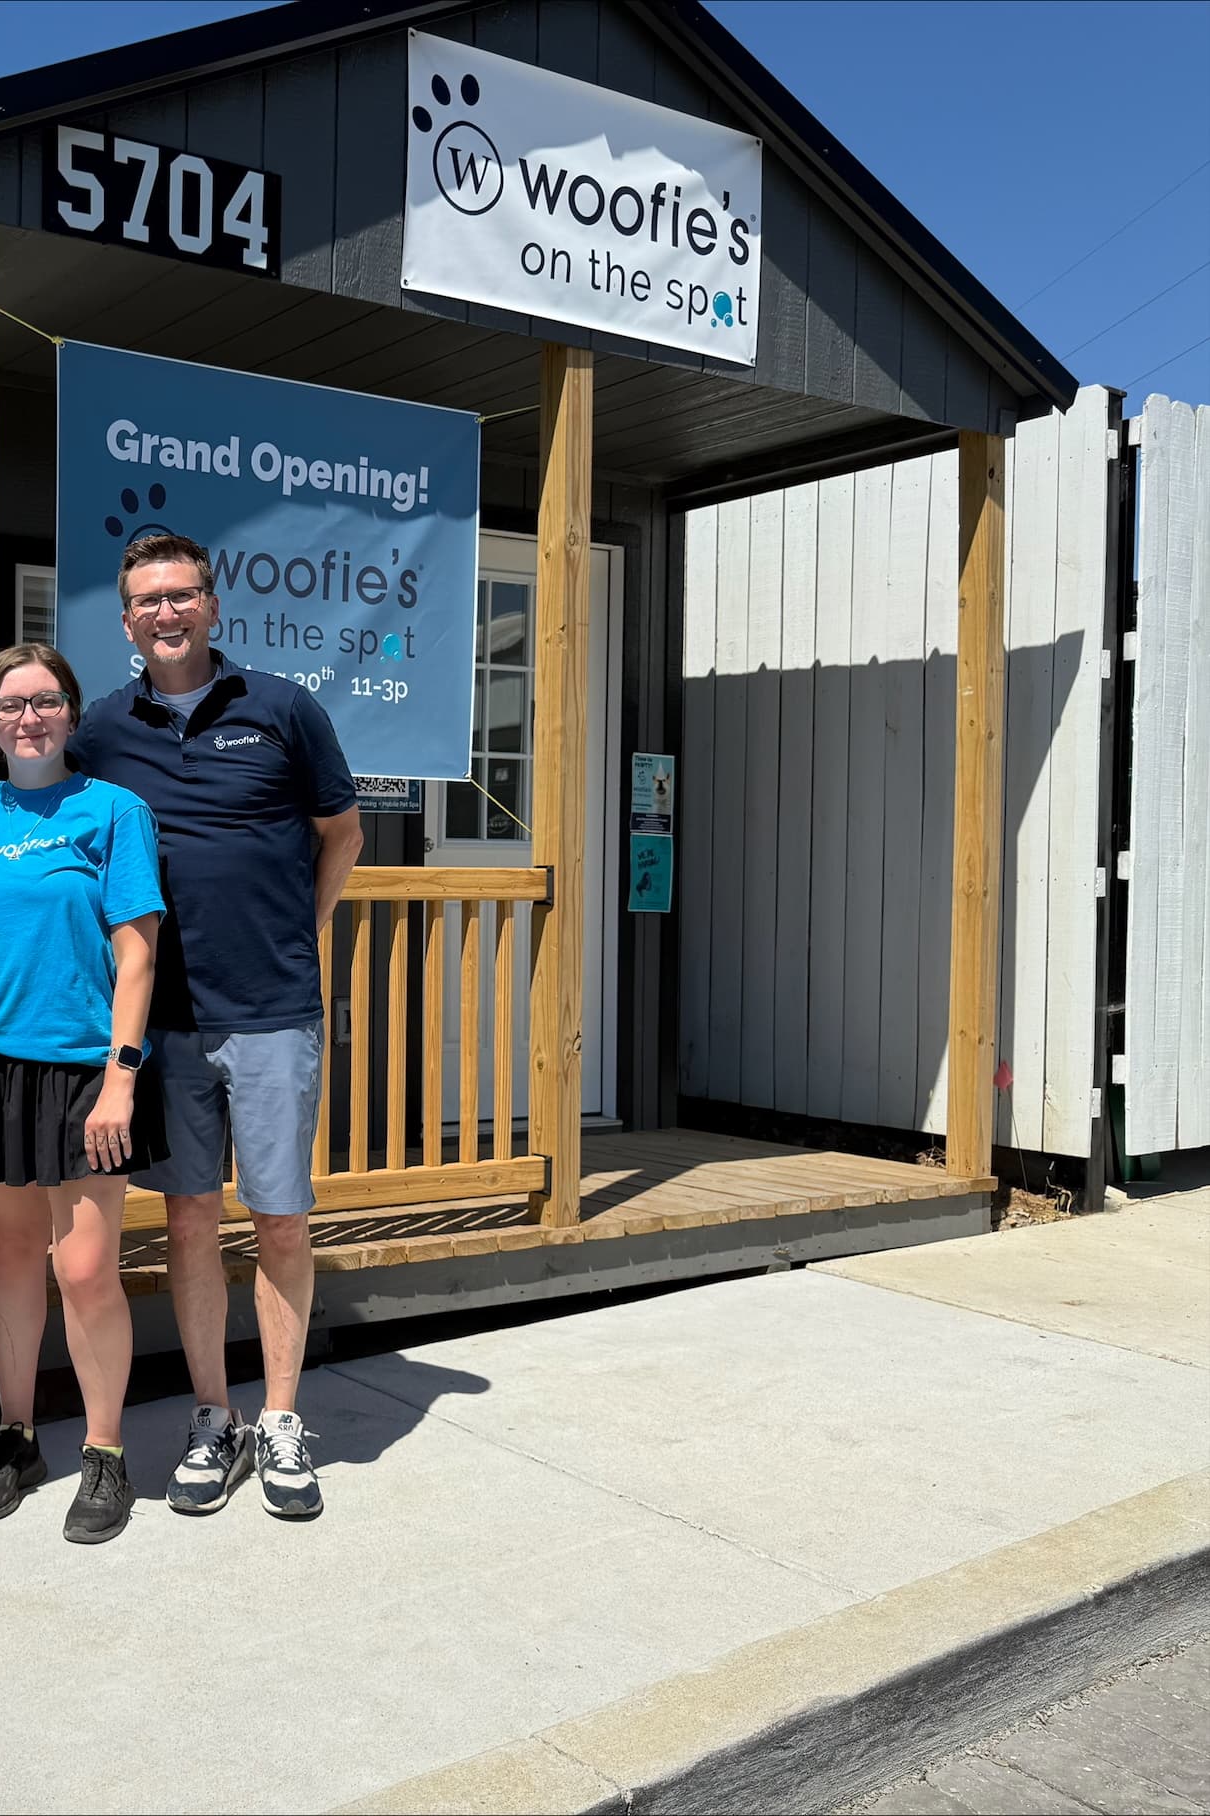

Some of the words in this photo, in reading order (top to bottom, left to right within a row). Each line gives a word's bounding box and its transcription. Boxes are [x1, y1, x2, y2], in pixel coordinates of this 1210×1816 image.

[57, 124, 268, 270] 5704
[518, 157, 750, 266] woofie's
[521, 242, 571, 284] on
[589, 248, 651, 302] the
[106, 418, 240, 478] Grand
[251, 441, 429, 512] Opening!
[264, 612, 324, 651] the
[351, 675, 409, 704] 11-3p
